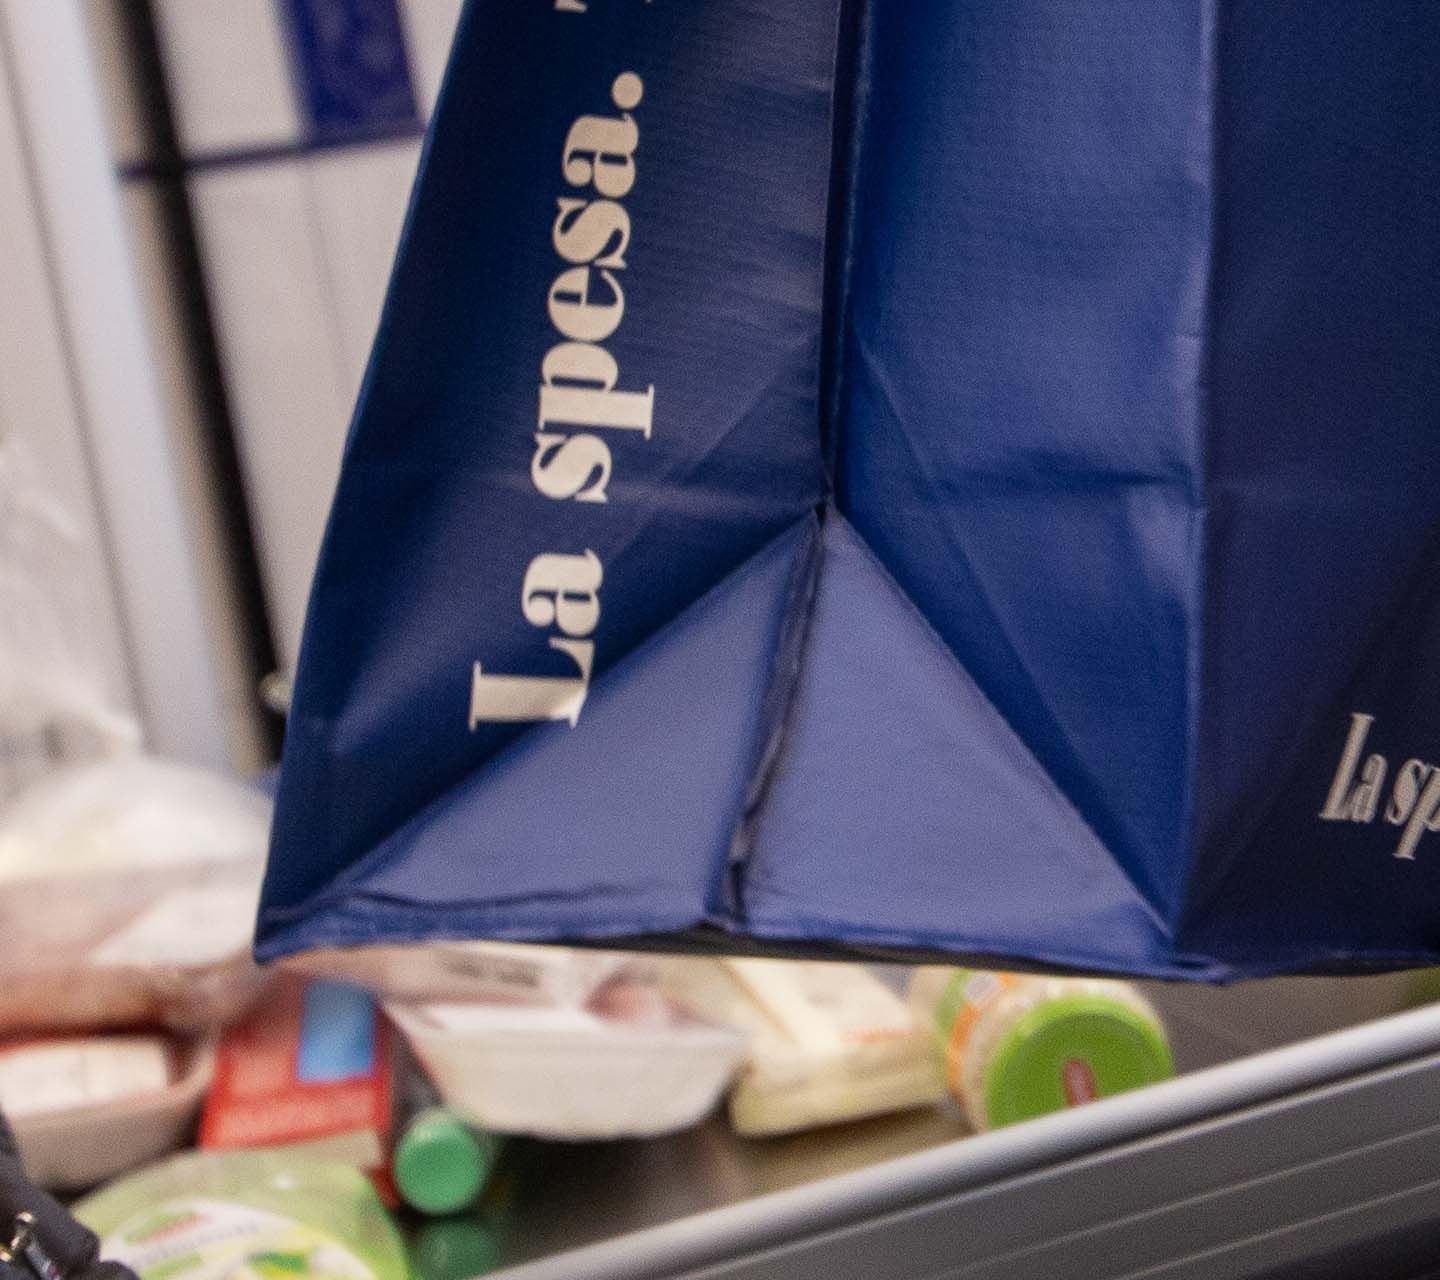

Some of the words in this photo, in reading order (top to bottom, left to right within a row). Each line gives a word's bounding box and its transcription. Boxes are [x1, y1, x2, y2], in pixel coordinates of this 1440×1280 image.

[529, 71, 657, 505] spesa.
[468, 548, 604, 731] La
[1317, 711, 1389, 824] La
